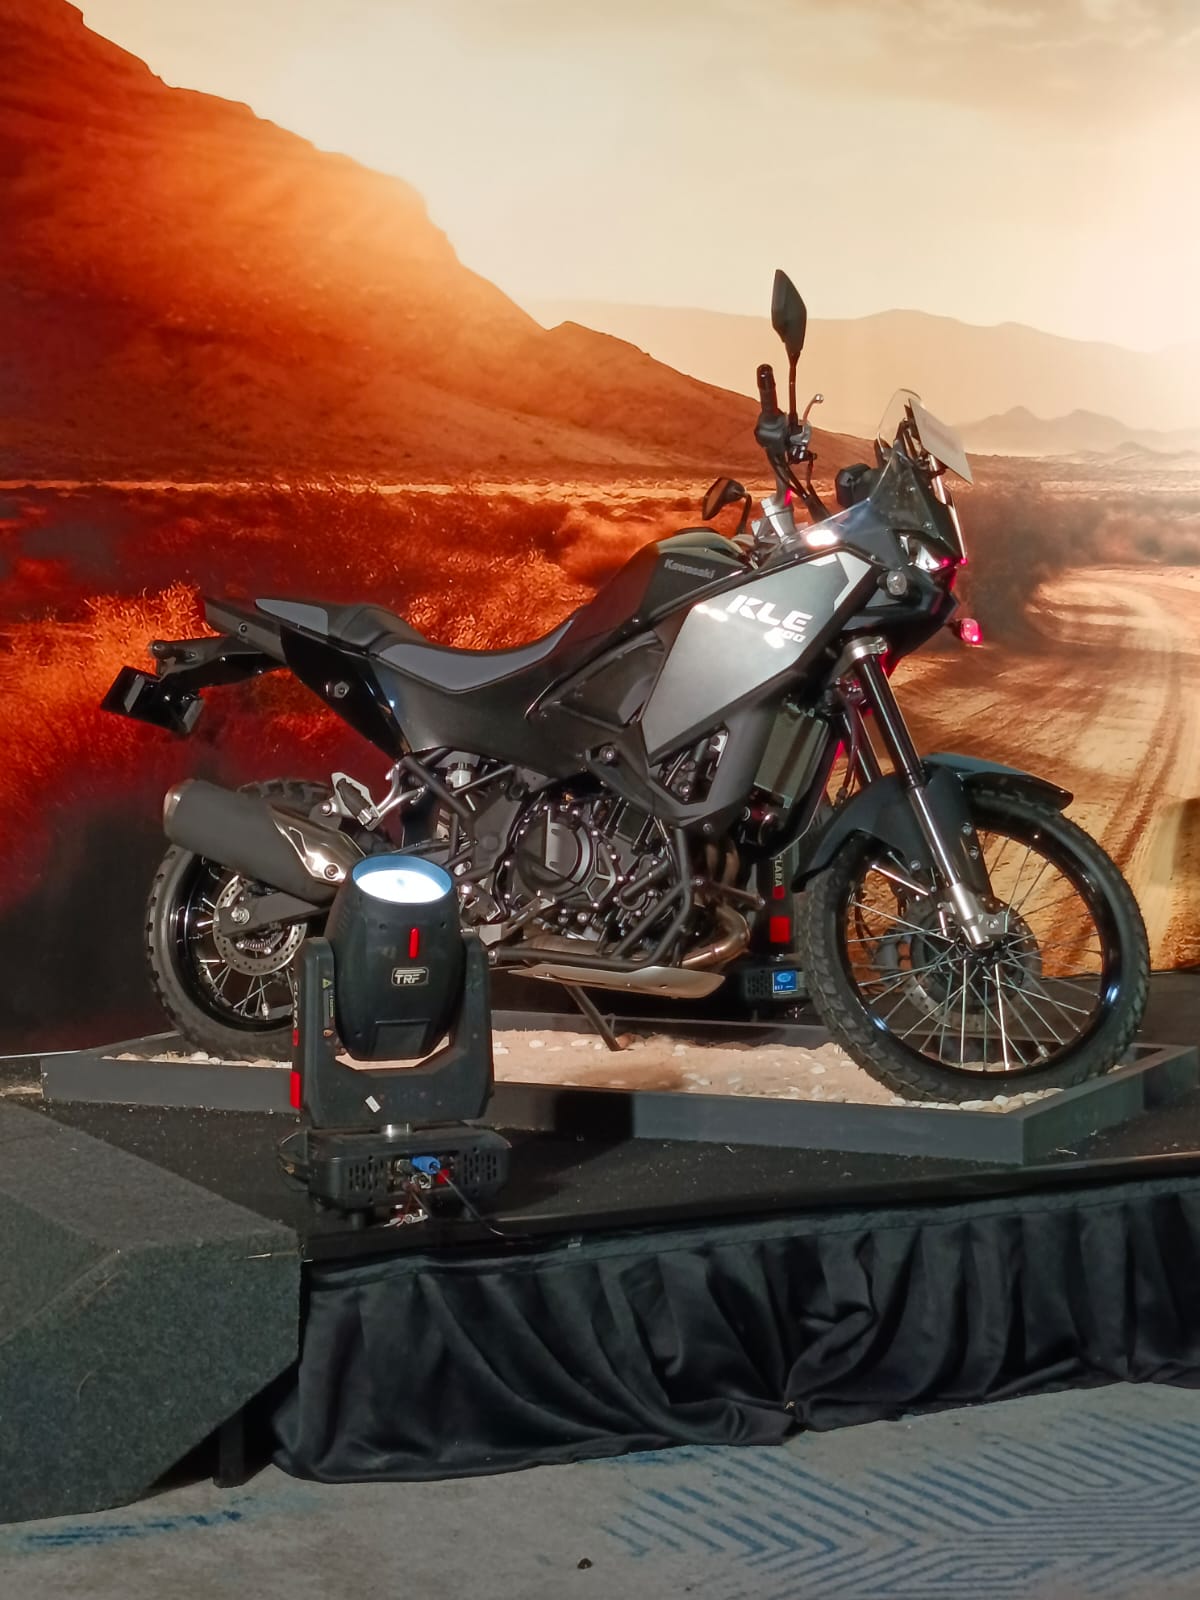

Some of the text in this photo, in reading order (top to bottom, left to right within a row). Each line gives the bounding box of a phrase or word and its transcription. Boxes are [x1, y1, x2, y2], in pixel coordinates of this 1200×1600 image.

[664, 559, 715, 579] Kawasaki
[726, 595, 812, 632] KLE
[769, 627, 806, 643] 00
[774, 856, 783, 887] LARA
[394, 974, 420, 984] TRF
